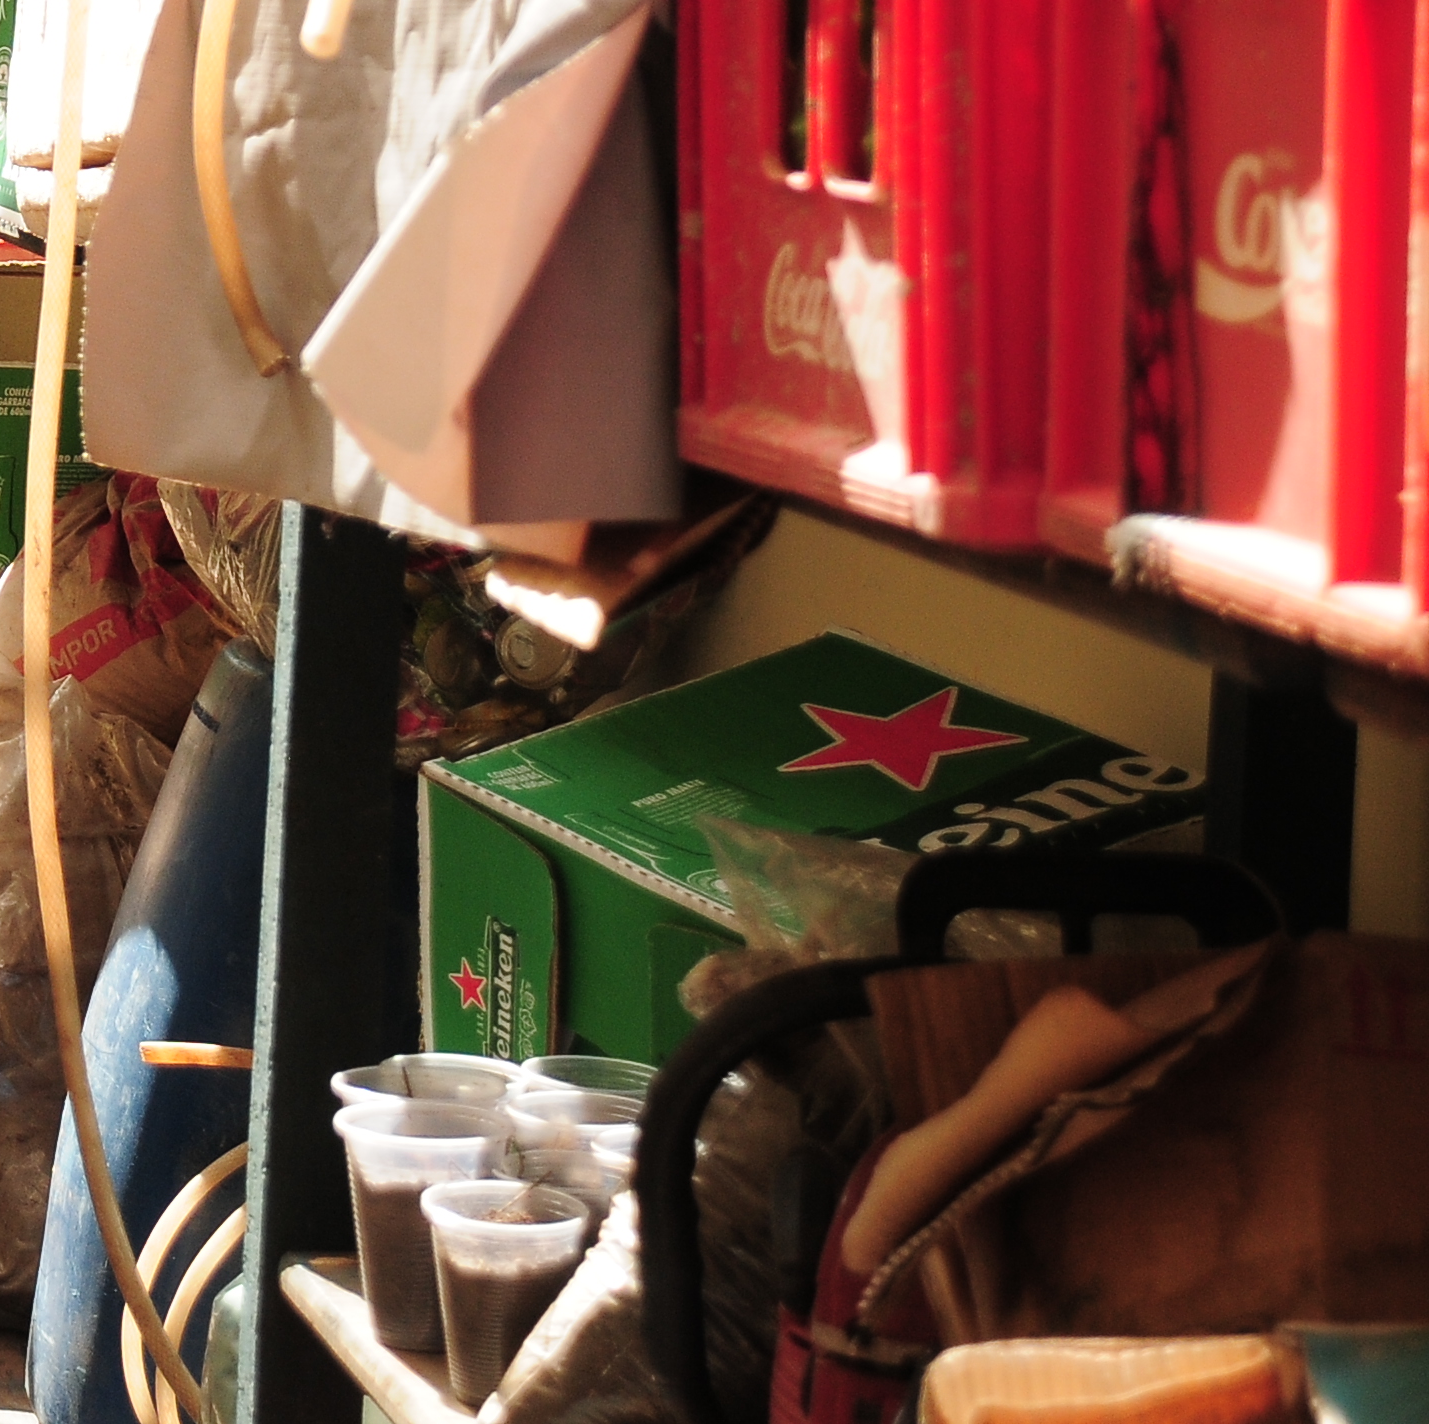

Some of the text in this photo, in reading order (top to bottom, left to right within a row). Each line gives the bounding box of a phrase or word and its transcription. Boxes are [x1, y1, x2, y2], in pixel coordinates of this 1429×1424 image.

[10, 406, 32, 416] 600m
[49, 618, 118, 677] MPOR
[630, 792, 667, 808] PURO
[918, 755, 1206, 853] eine
[492, 932, 514, 1060] eineken
